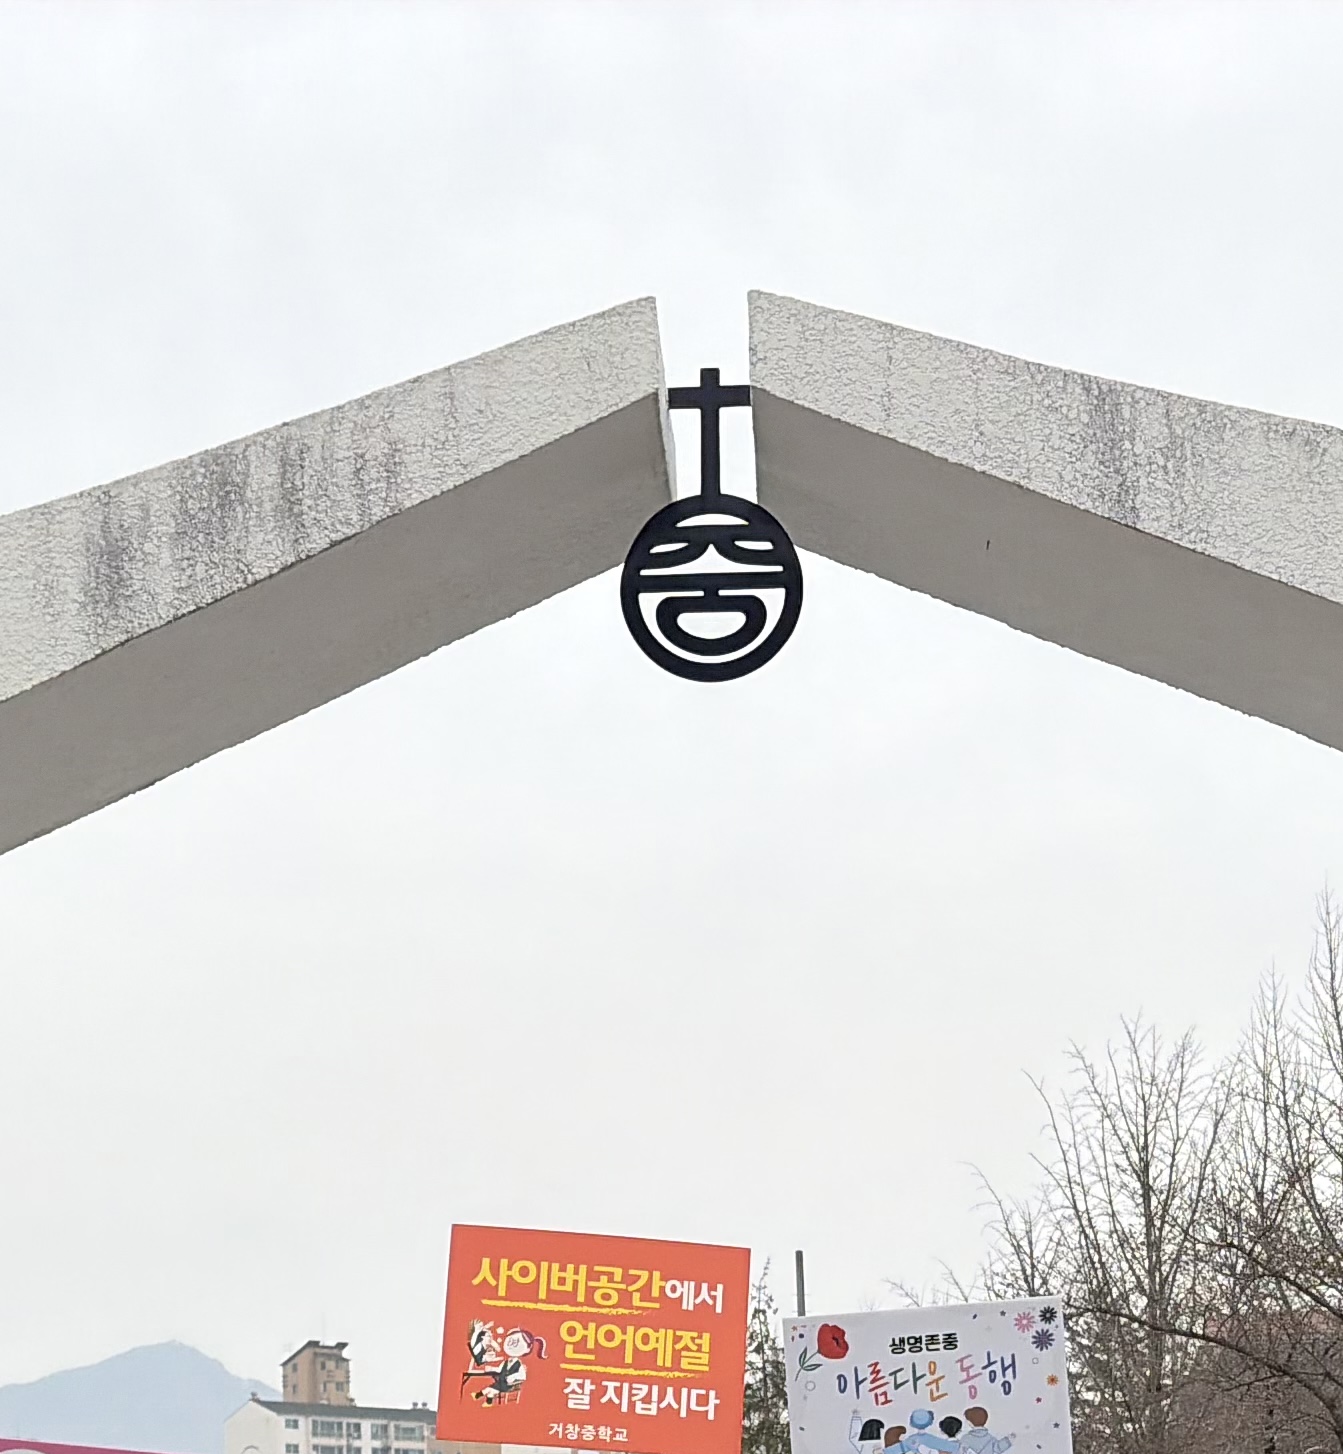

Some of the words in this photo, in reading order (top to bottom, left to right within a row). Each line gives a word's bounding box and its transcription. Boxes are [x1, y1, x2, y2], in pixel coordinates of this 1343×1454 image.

[471, 1257, 724, 1314] 사이버공간에서
[559, 1320, 711, 1372] 언어예절
[888, 1332, 959, 1355] 생명존중
[563, 1377, 595, 1411] 잘
[600, 1380, 721, 1421] 지킵시다
[837, 1361, 948, 1407] 아름다운
[956, 1351, 1017, 1400] 동행
[548, 1423, 629, 1443] 거창중학교
